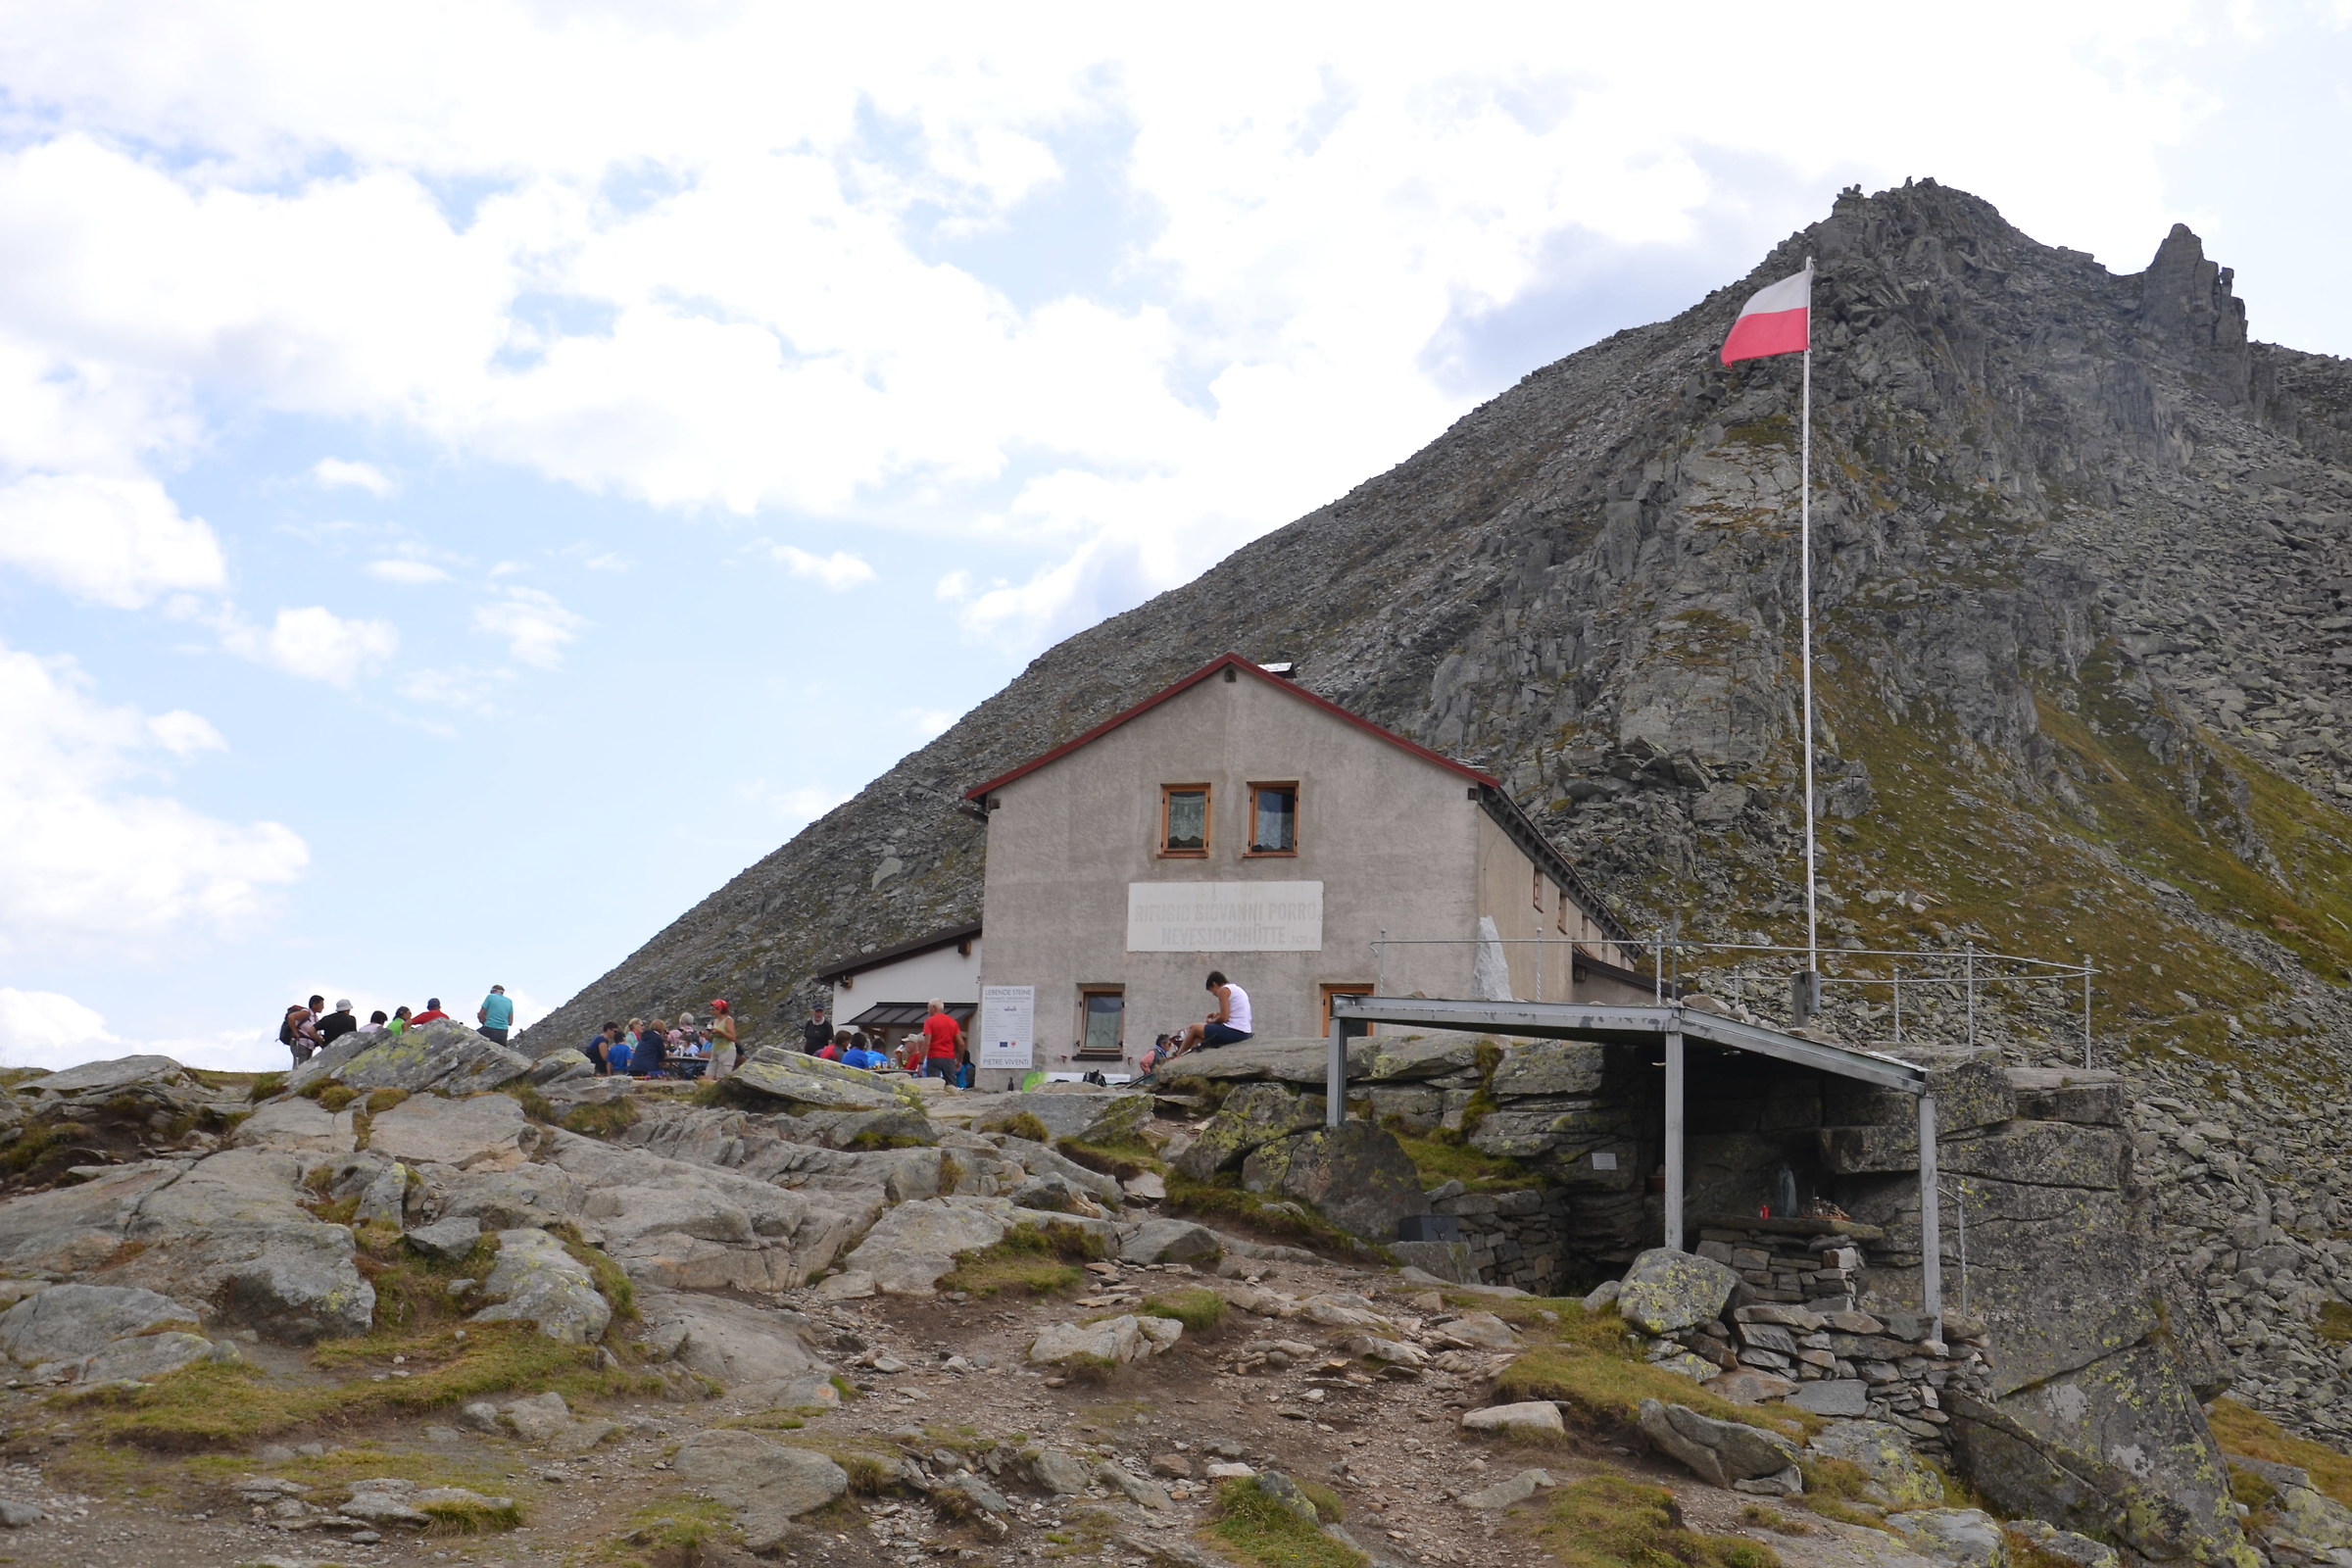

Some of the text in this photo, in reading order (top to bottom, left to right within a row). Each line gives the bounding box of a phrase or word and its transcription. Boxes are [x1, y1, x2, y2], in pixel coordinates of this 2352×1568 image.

[1135, 902, 1316, 923] RIFUGIO GIOVANNI PORRO
[1161, 923, 1286, 946] NEVESJOCHHÜTTE
